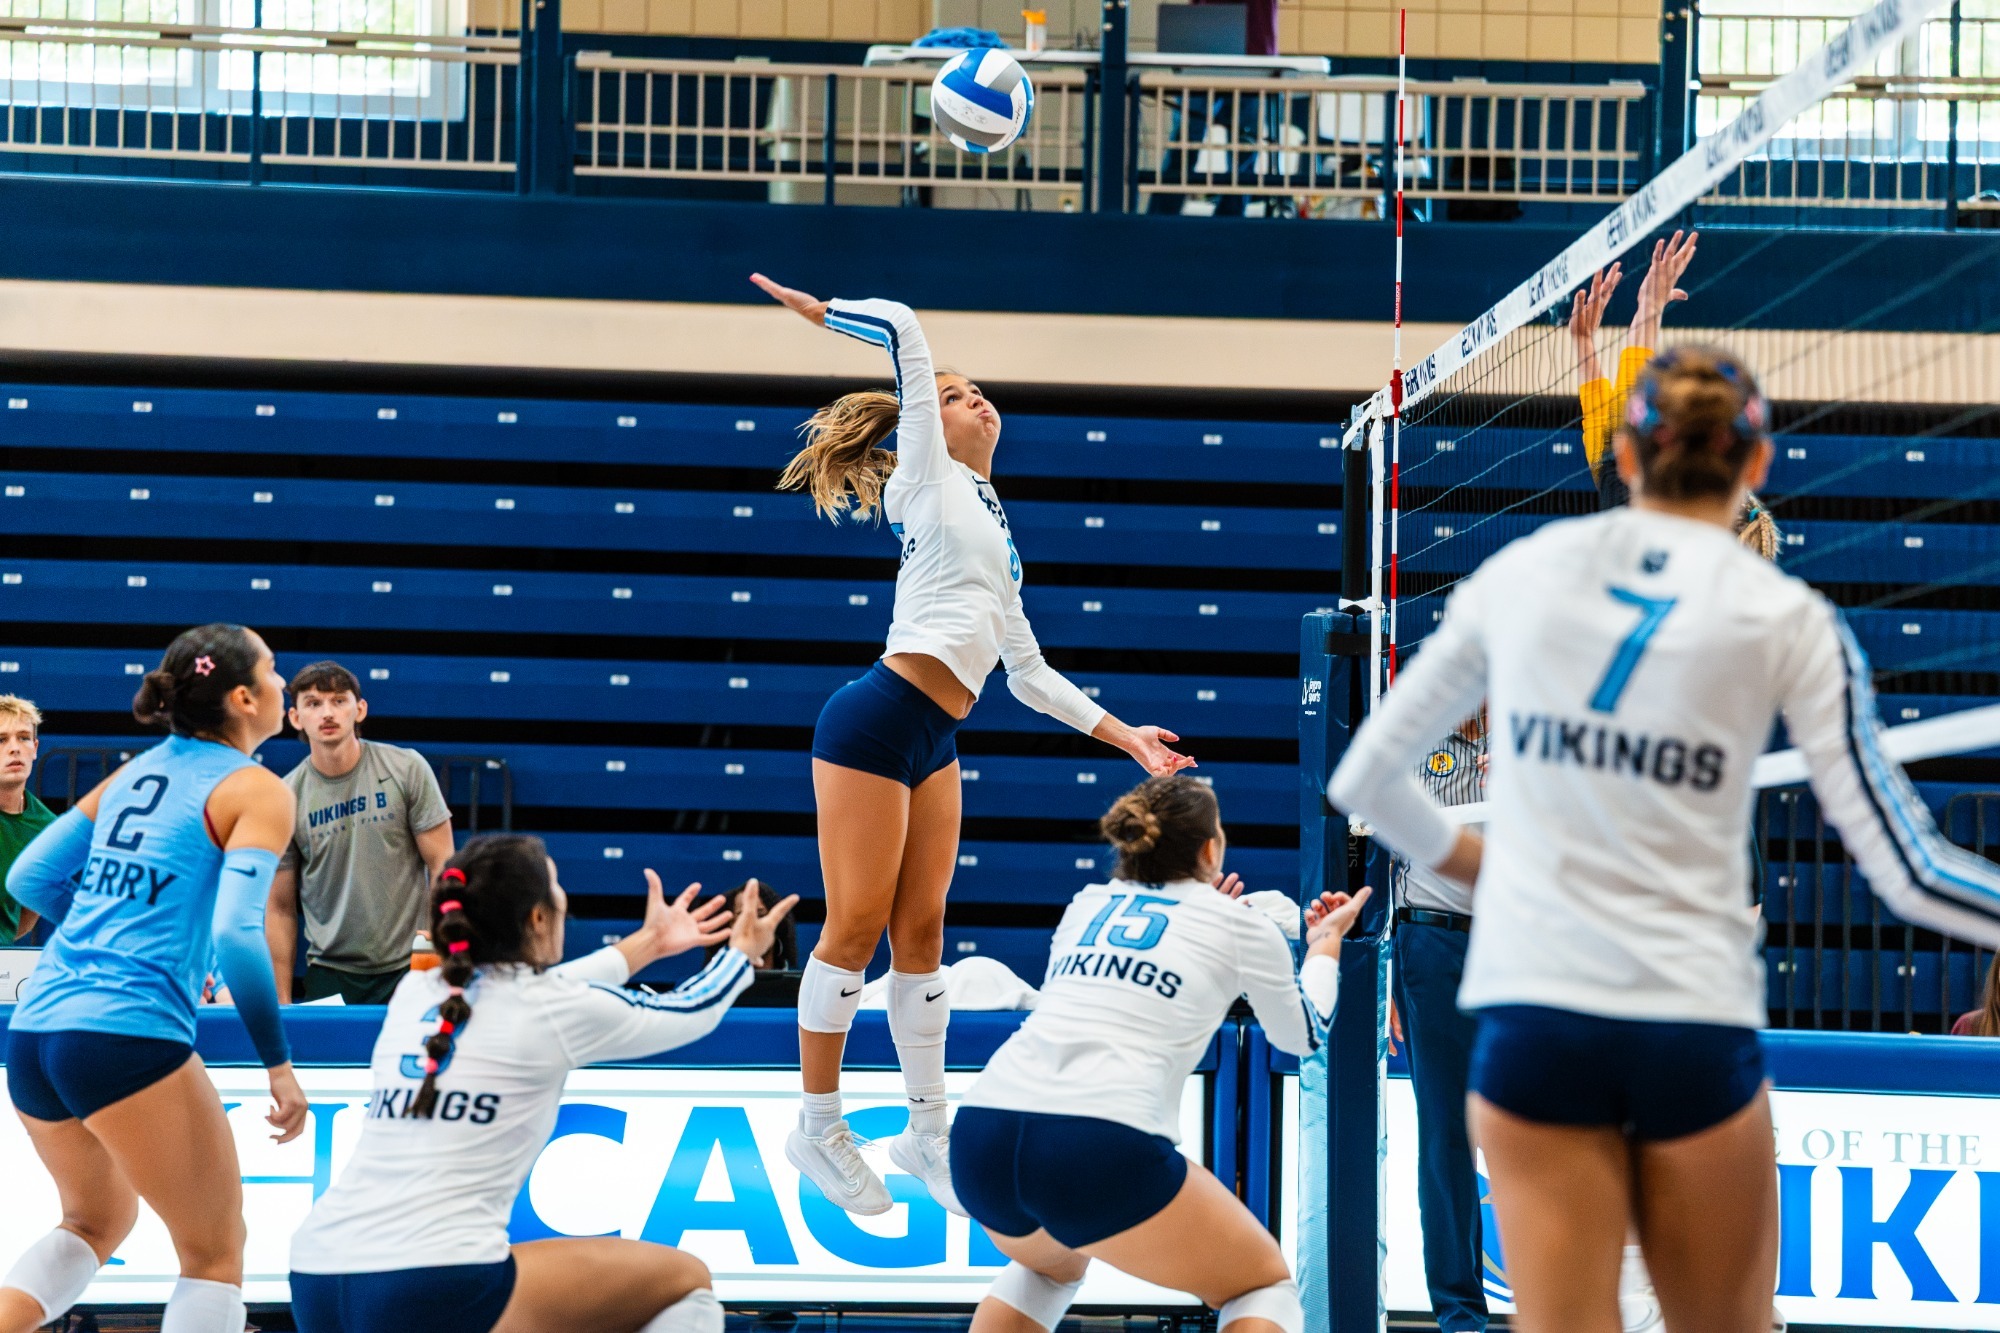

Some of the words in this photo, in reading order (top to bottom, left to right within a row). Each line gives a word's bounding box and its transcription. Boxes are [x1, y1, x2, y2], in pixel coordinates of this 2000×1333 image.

[1588, 584, 1678, 713] 7
[1509, 712, 1725, 793] VIKINGS
[106, 774, 169, 852] 2
[308, 796, 366, 827] VIKINGS
[375, 792, 387, 809] B
[80, 857, 178, 906] ERRY
[1076, 894, 1181, 951] 15
[1050, 953, 1183, 999] VIKINGS
[399, 1003, 471, 1079] 3
[1802, 1128, 1864, 1161] OF
[1882, 1131, 1982, 1166] THE
[508, 1103, 1012, 1268] CAG
